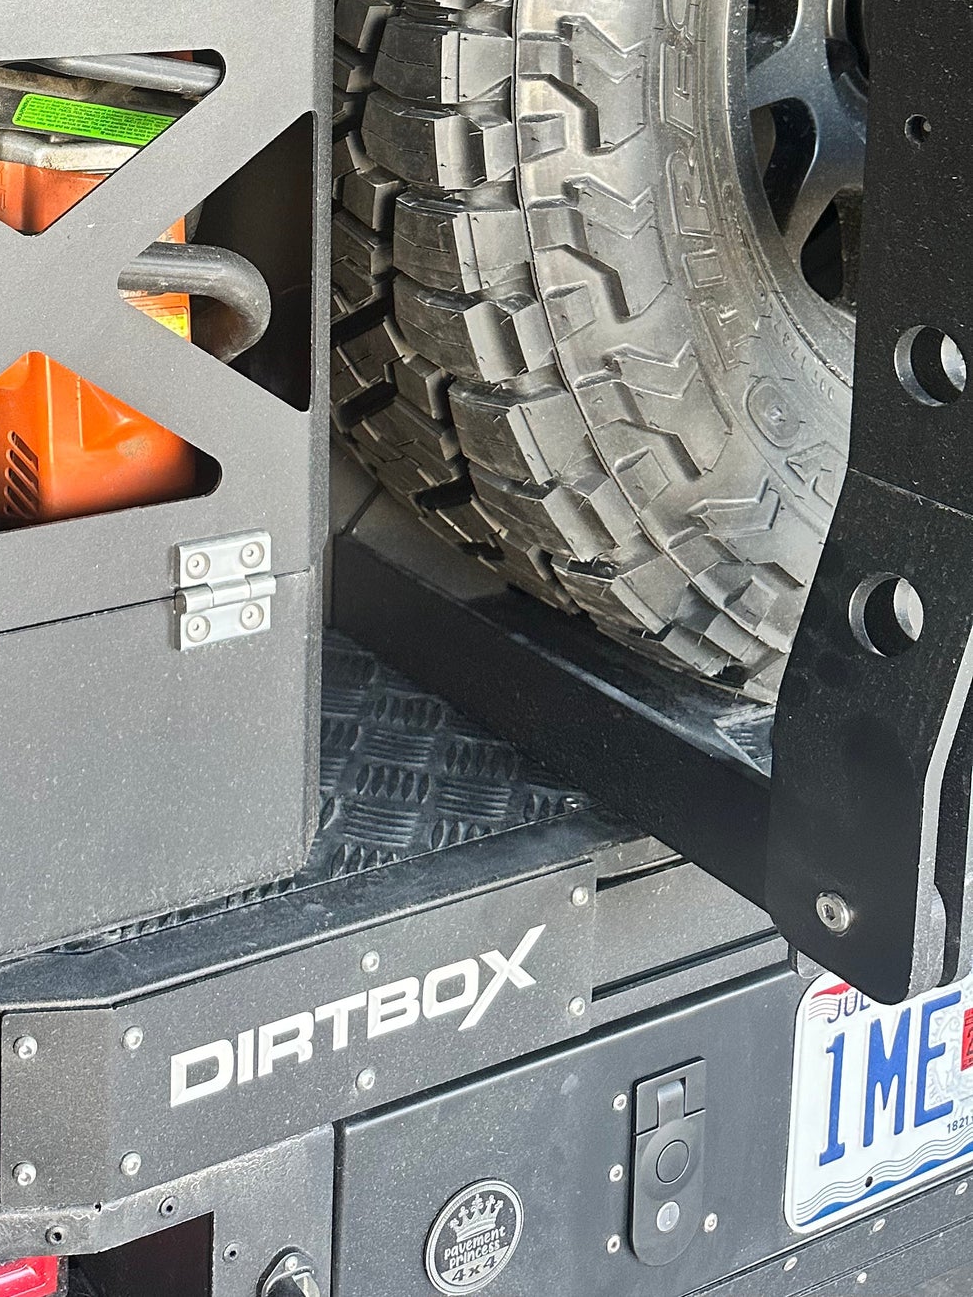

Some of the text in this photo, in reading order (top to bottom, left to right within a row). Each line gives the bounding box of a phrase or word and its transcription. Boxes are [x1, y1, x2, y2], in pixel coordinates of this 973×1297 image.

[170, 923, 547, 1108] DIRTBOX
[444, 1225, 507, 1261] pavement
[449, 1239, 501, 1269] princess
